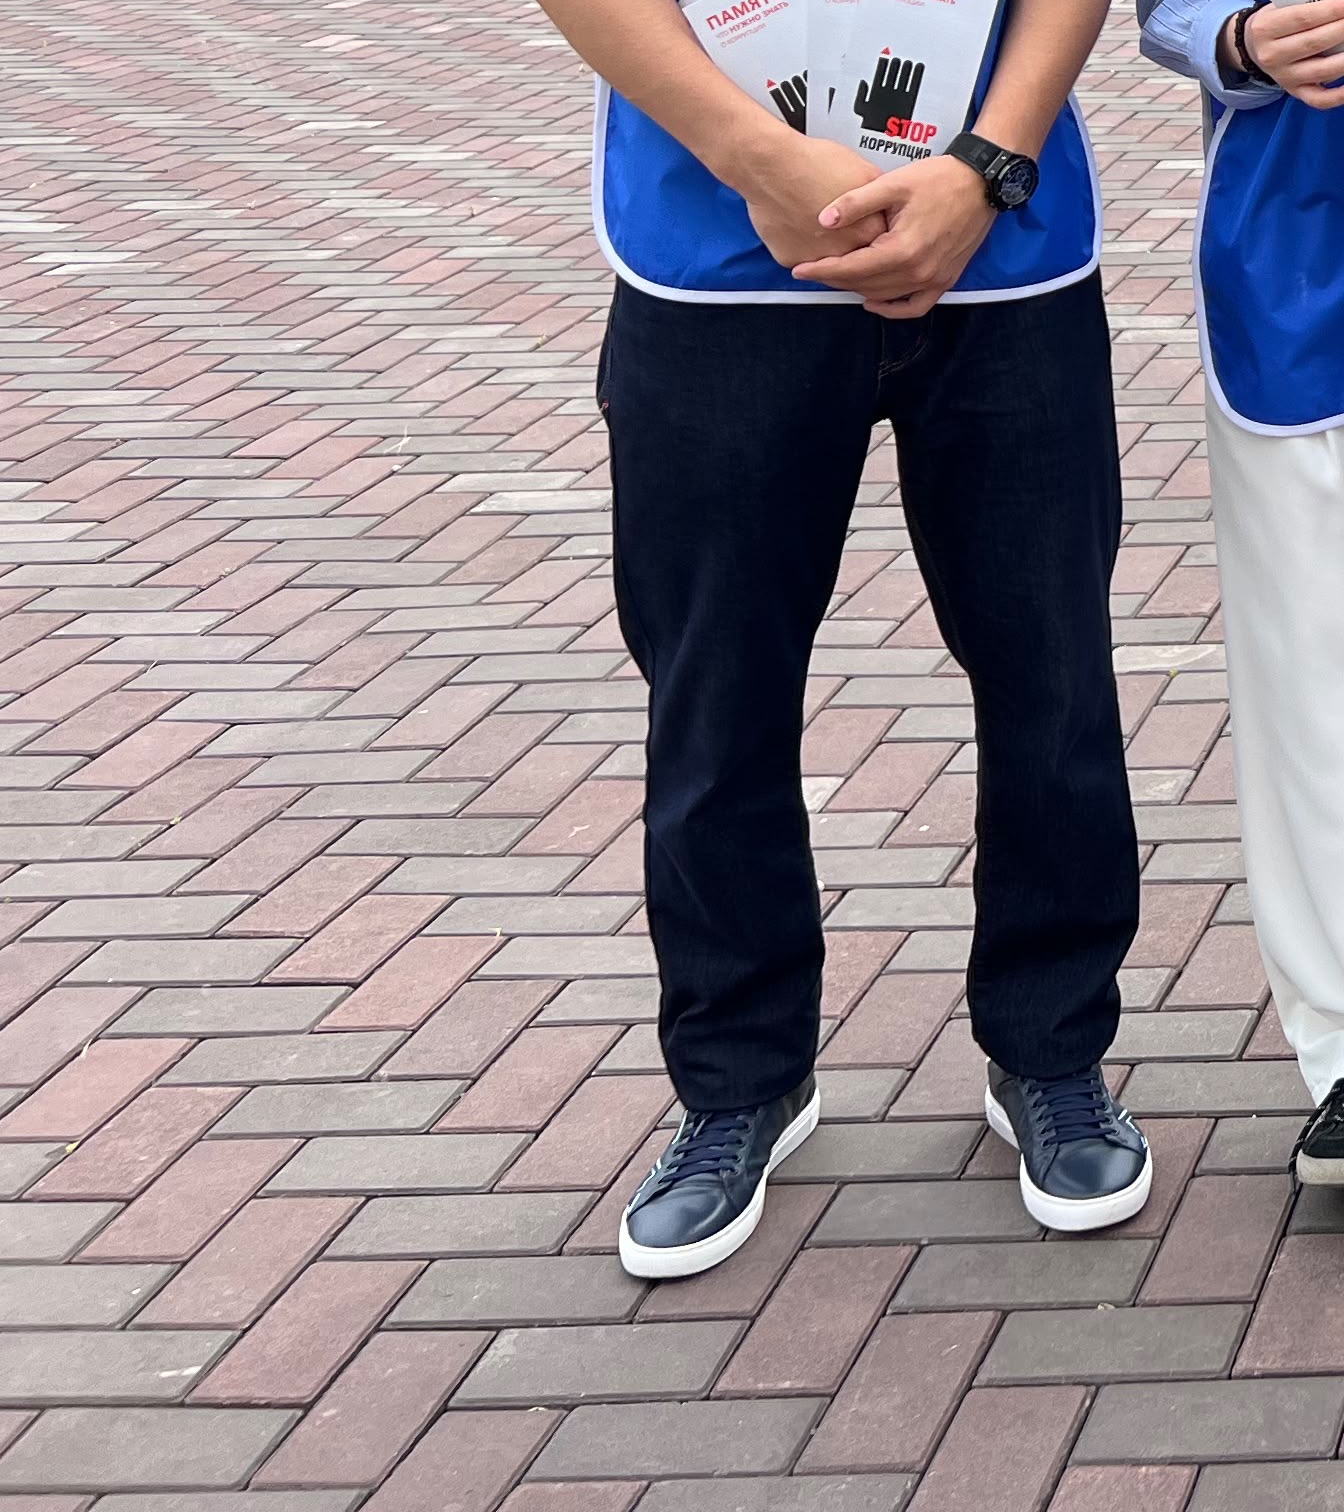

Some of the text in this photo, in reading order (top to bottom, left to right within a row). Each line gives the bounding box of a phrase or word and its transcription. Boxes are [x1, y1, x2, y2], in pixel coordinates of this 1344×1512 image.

[729, 13, 761, 33] НУЖНО
[762, 1, 789, 17] ЗНАТЬ
[885, 116, 937, 144] STOP
[859, 135, 932, 161] КОРРУПЦИЯ
